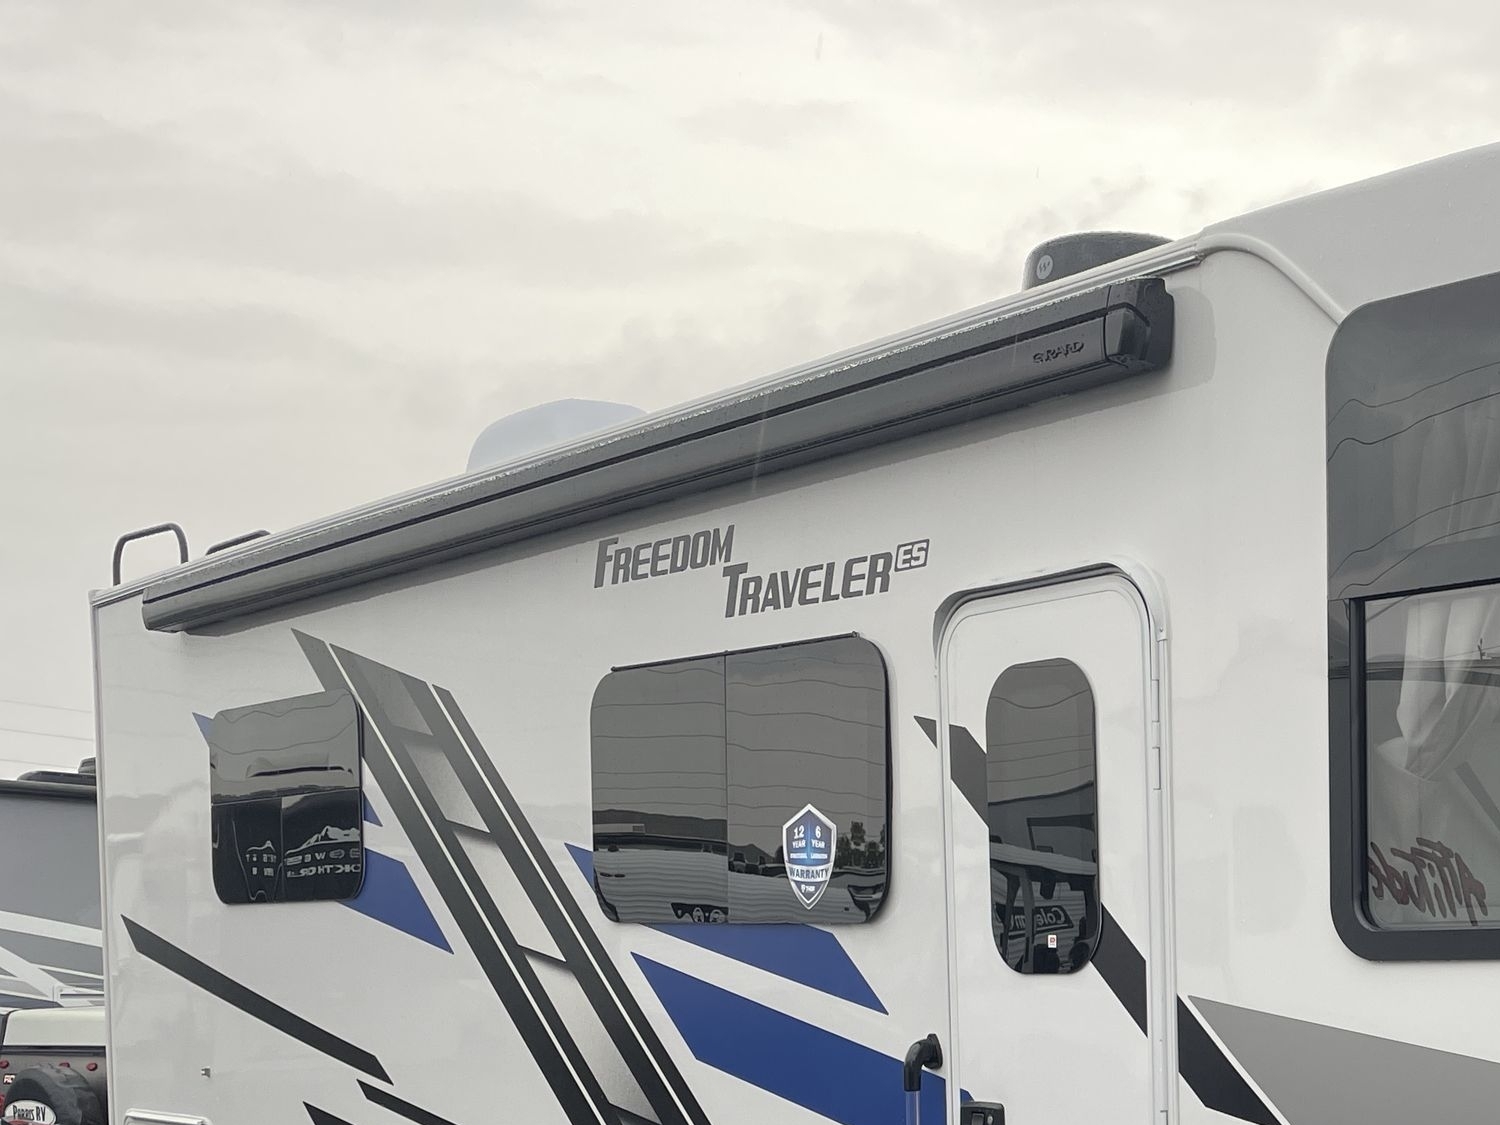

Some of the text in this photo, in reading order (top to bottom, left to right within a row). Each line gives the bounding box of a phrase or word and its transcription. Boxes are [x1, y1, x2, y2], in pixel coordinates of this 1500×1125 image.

[594, 524, 735, 588] FREEDOM
[722, 542, 926, 618] TRAVELER ES
[793, 824, 822, 840] 12 6
[792, 839, 826, 849] YEAR YEAR
[788, 867, 830, 880] WARRANTY
